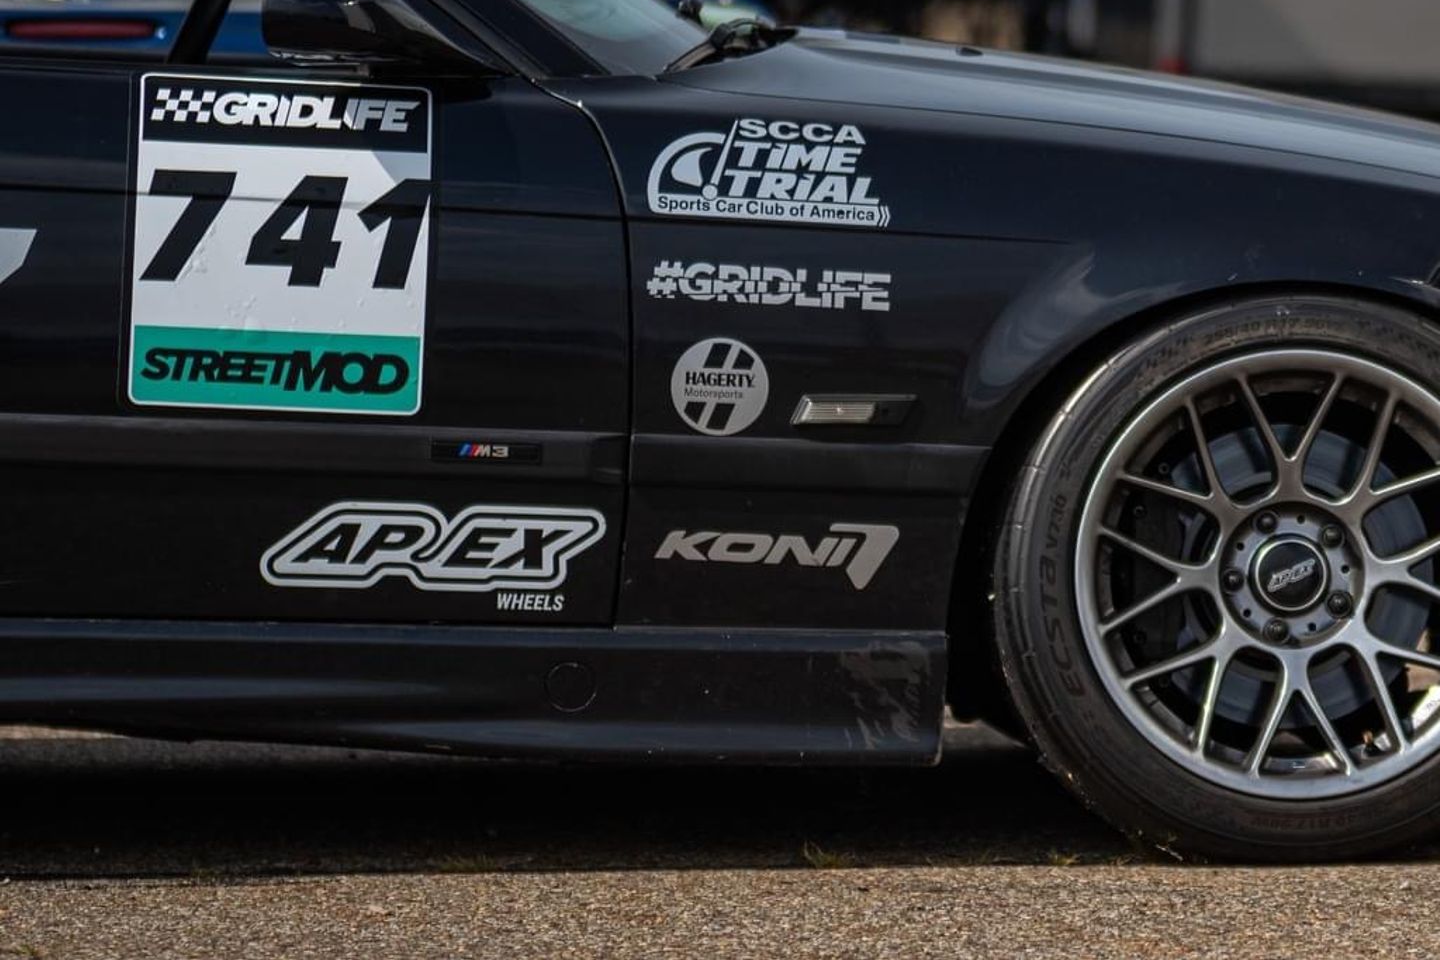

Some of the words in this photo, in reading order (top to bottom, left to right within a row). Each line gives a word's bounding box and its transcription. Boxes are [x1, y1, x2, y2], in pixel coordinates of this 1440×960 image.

[738, 118, 867, 144] SCCA
[733, 140, 863, 174] TIME
[724, 169, 880, 205] TRIAL
[658, 196, 711, 213] Sports
[715, 199, 744, 214] Car
[746, 200, 785, 216] Club
[790, 203, 806, 218] of
[809, 206, 876, 222] America
[138, 168, 437, 291] 741
[684, 371, 754, 389] HAGERTY
[496, 593, 565, 612] WHEELS
